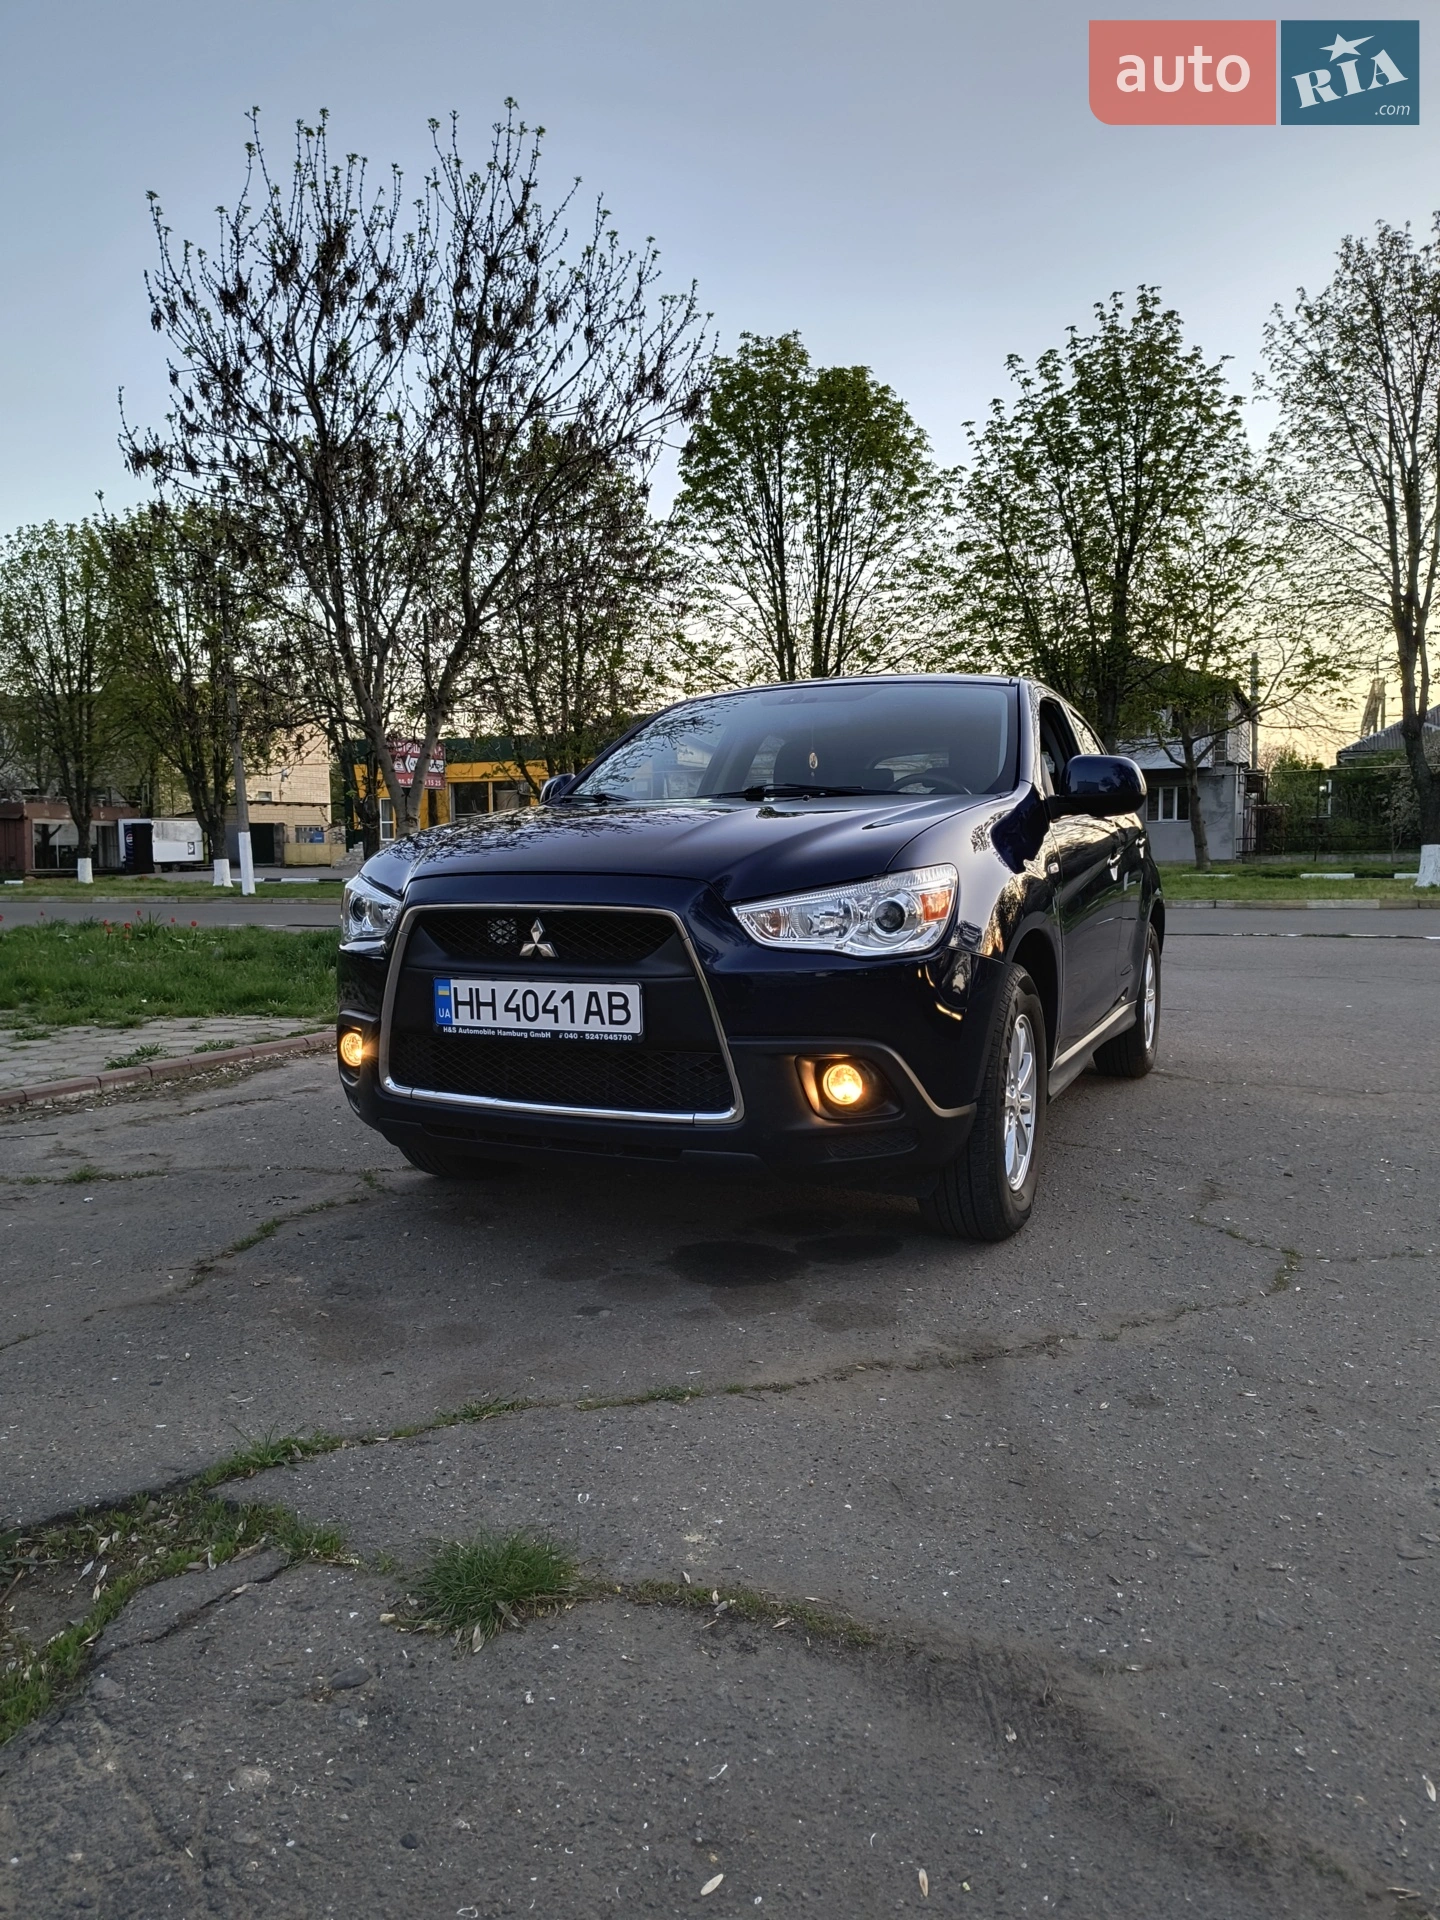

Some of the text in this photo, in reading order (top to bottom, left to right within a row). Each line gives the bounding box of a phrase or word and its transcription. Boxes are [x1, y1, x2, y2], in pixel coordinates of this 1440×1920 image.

[453, 986, 632, 1026] HH 4041 AB
[438, 1008, 451, 1018] UA
[458, 1027, 495, 1035] Automobile
[497, 1029, 528, 1038] Hamburg
